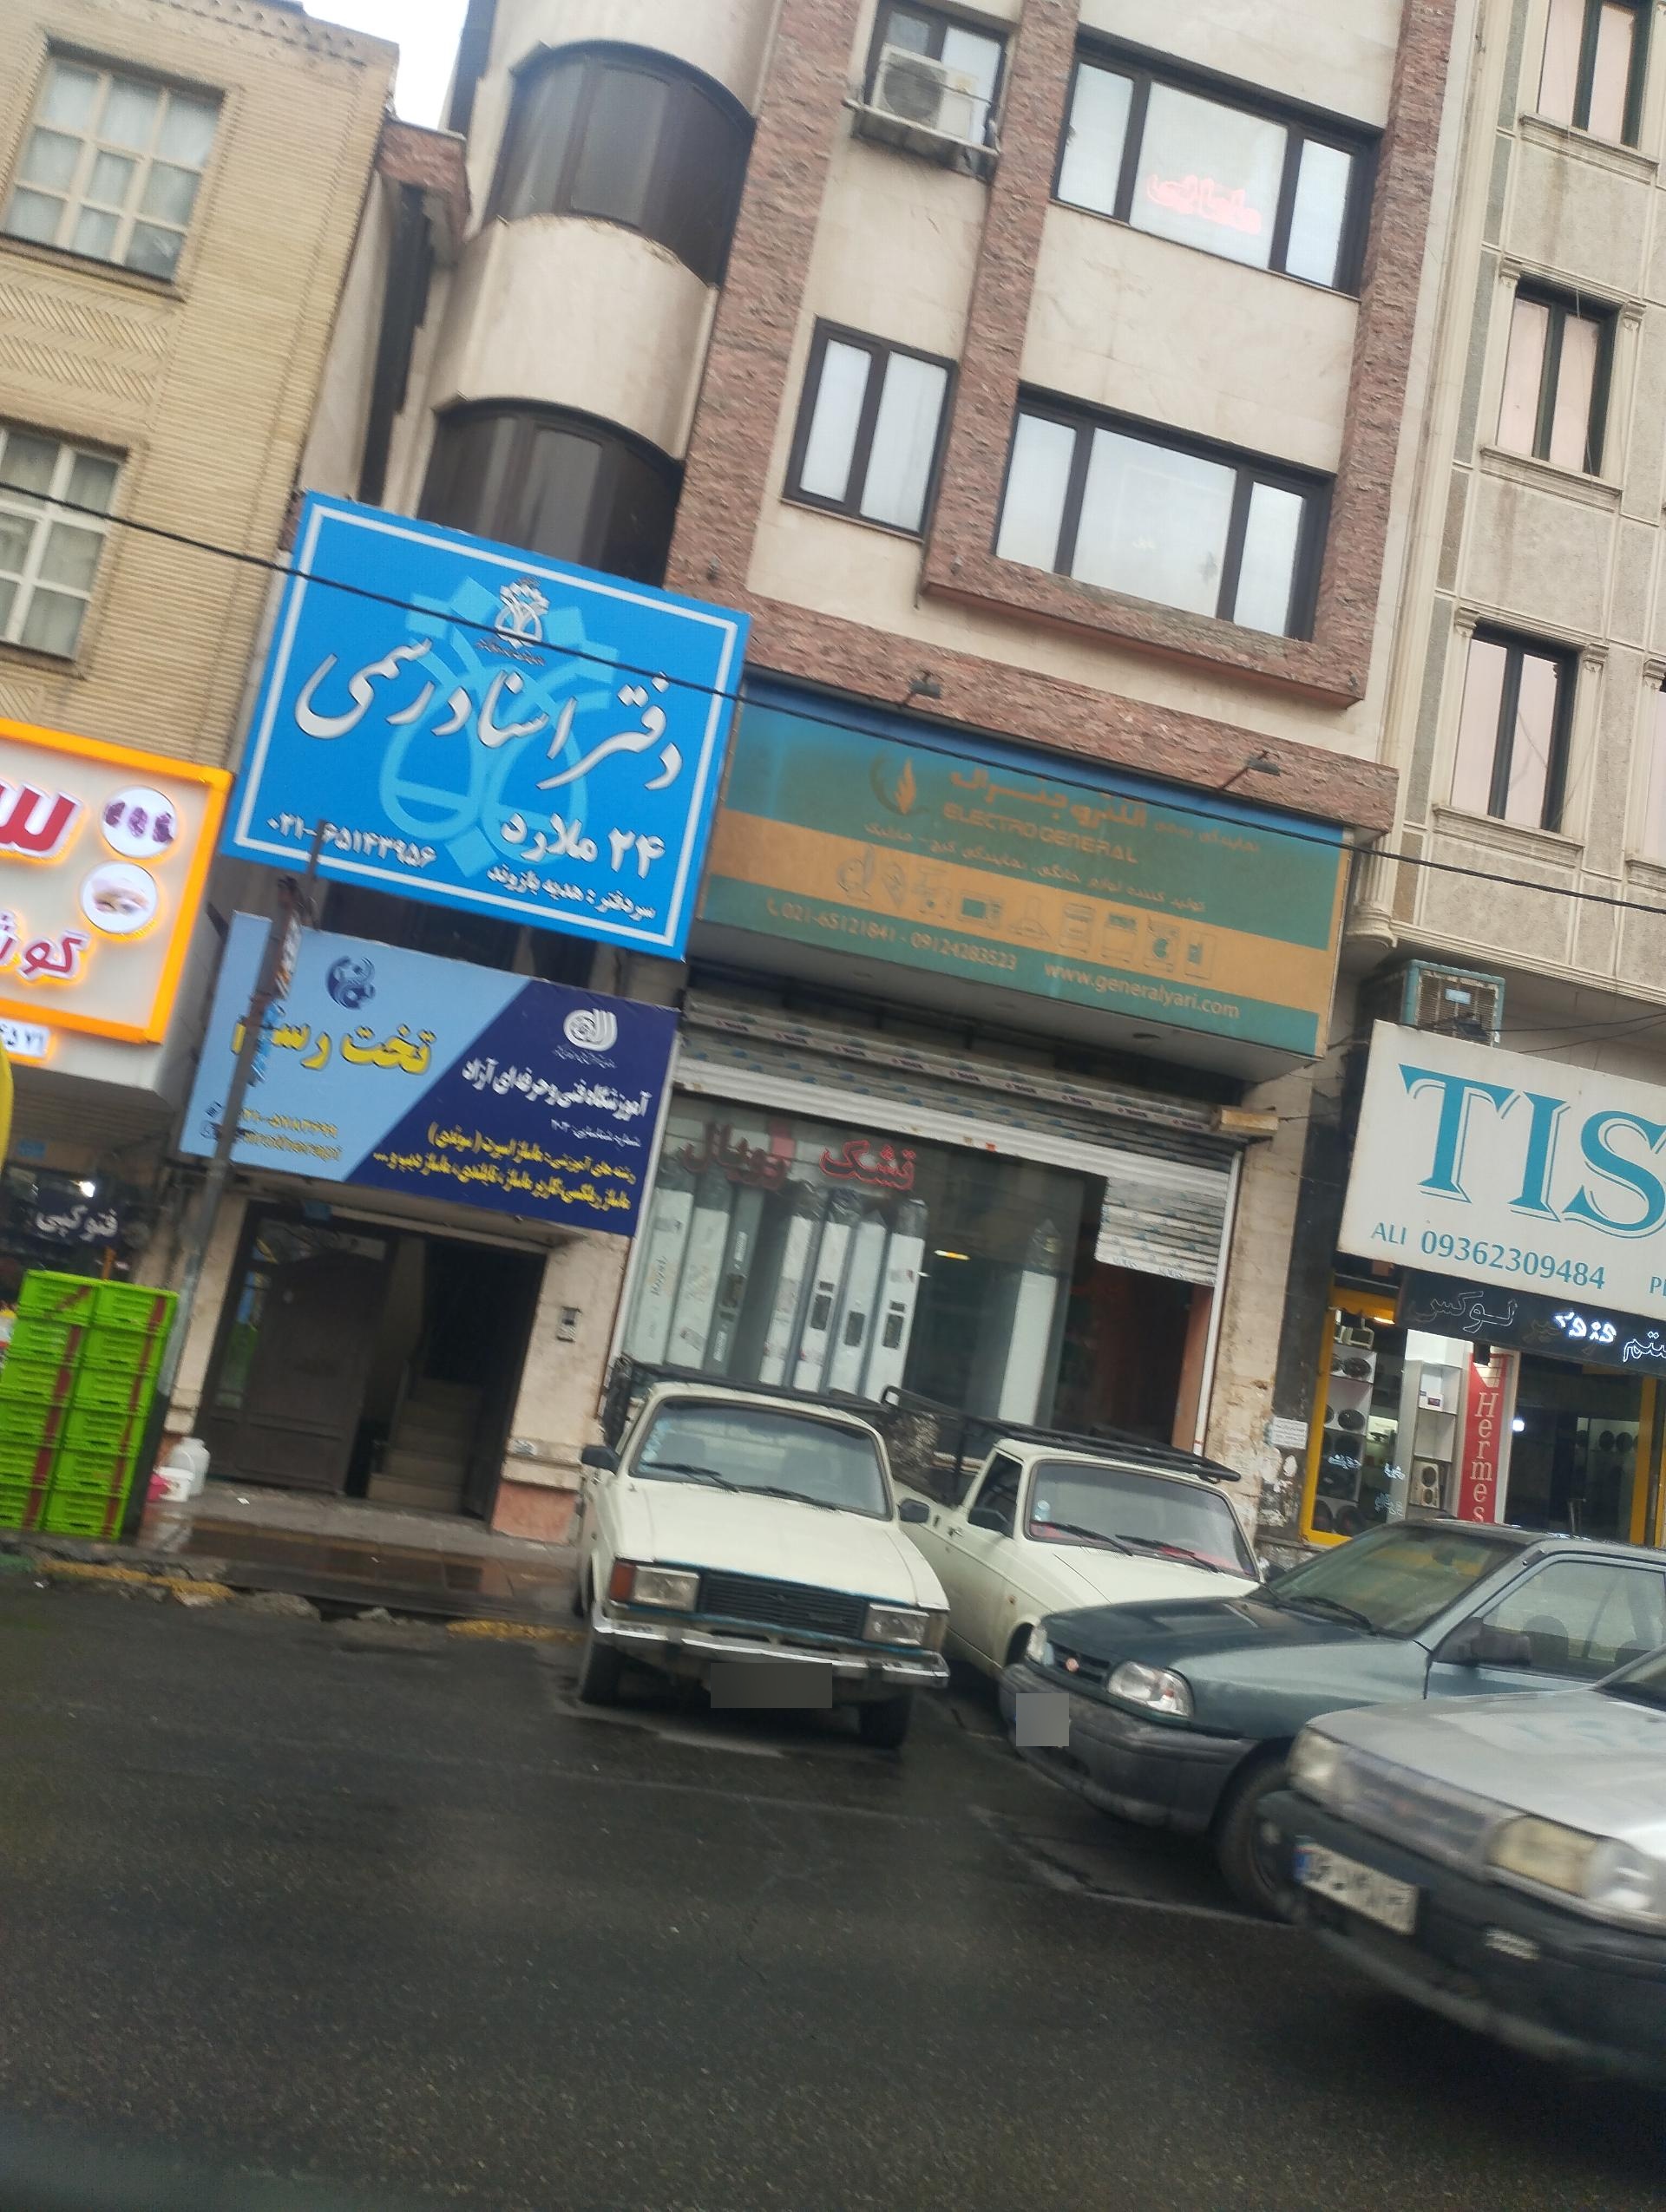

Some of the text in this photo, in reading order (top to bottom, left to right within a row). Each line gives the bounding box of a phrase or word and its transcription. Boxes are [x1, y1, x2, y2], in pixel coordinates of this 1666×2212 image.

[295, 638, 683, 791] دفتر اسناد رسمی
[501, 812, 666, 879] ۲۴ ملارد
[339, 1024, 437, 1075] تخت
[818, 1138, 917, 1191] تشک
[1371, 1221, 1408, 1247] ALI
[1420, 1229, 1607, 1292] 09362309484
[1469, 1391, 1499, 1523] Hermes
